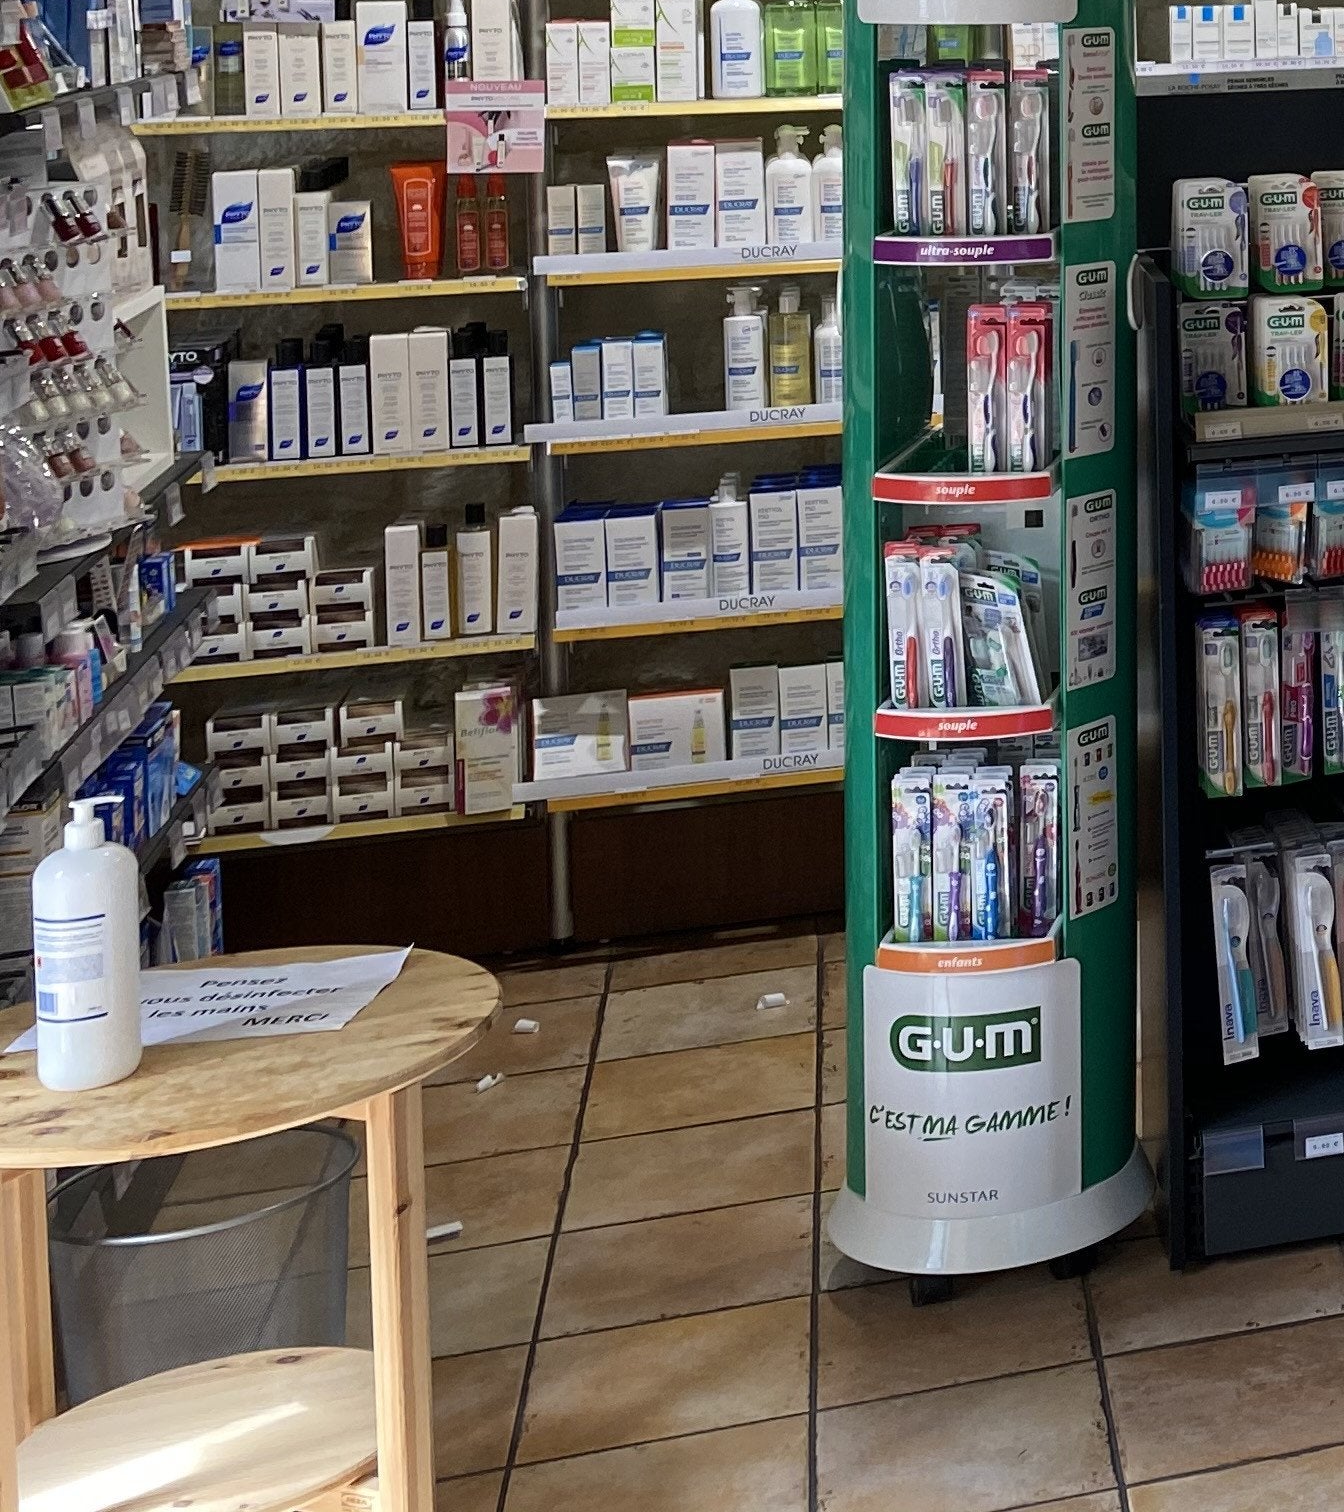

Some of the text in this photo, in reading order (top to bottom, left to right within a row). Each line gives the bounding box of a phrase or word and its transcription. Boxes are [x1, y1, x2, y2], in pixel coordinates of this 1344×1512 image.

[469, 82, 522, 92] NOUVEAU
[741, 244, 798, 259] DUCRAY
[920, 244, 995, 260] ultra-souple
[750, 406, 806, 422] DUCRAY
[935, 483, 976, 498] souple
[719, 596, 776, 611] DUCRAY
[937, 718, 978, 733] souple
[762, 753, 820, 770] DUCRAY
[936, 955, 983, 969] enfants
[200, 976, 289, 989] Pensez
[199, 985, 344, 1004] désinfecter
[148, 1003, 270, 1020] les mains
[242, 1013, 331, 1028] MERCI
[869, 1099, 1061, 1136] C'EST MA GAMME
[927, 1189, 1000, 1204] SUNSTAR
